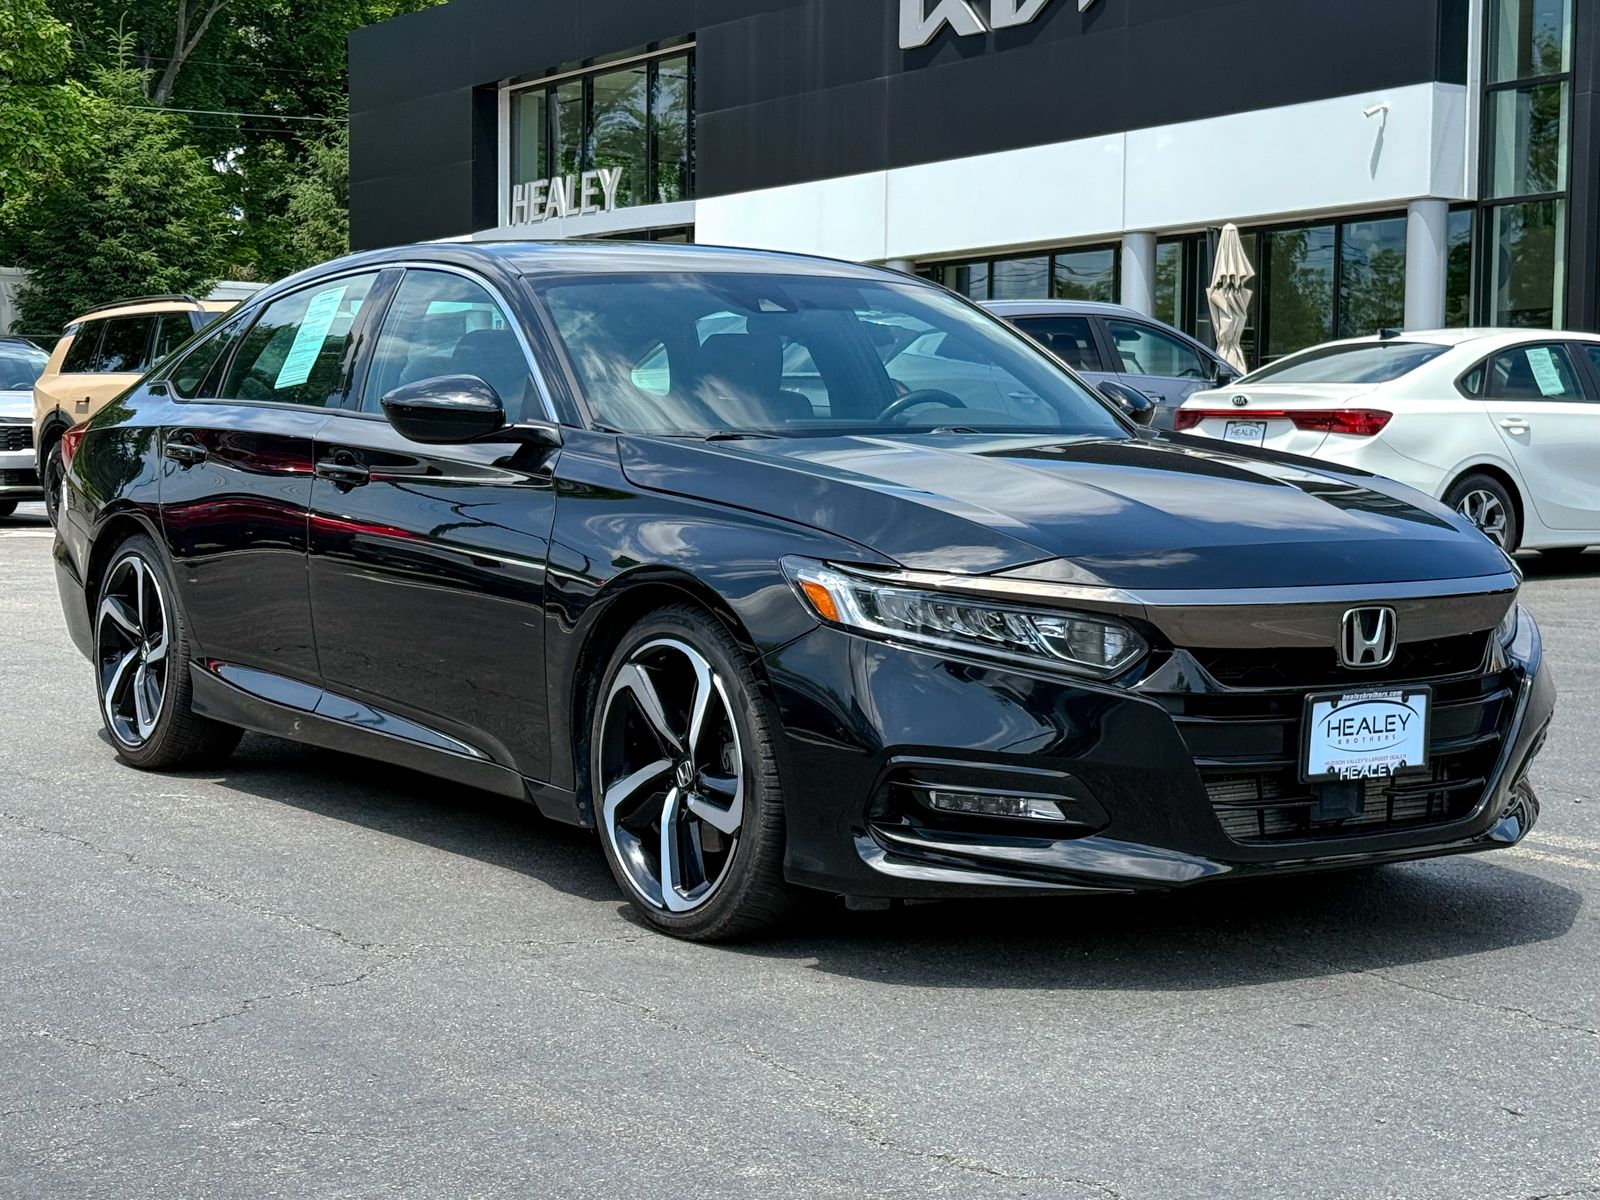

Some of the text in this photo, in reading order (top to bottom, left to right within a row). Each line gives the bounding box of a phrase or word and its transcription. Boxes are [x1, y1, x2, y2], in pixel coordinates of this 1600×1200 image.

[513, 166, 623, 227] HEALEY
[1230, 429, 1260, 437] HEALEY
[1327, 713, 1411, 738] HEALEY
[1338, 734, 1396, 745] BROTHERS
[1339, 762, 1397, 781] HEALEY
